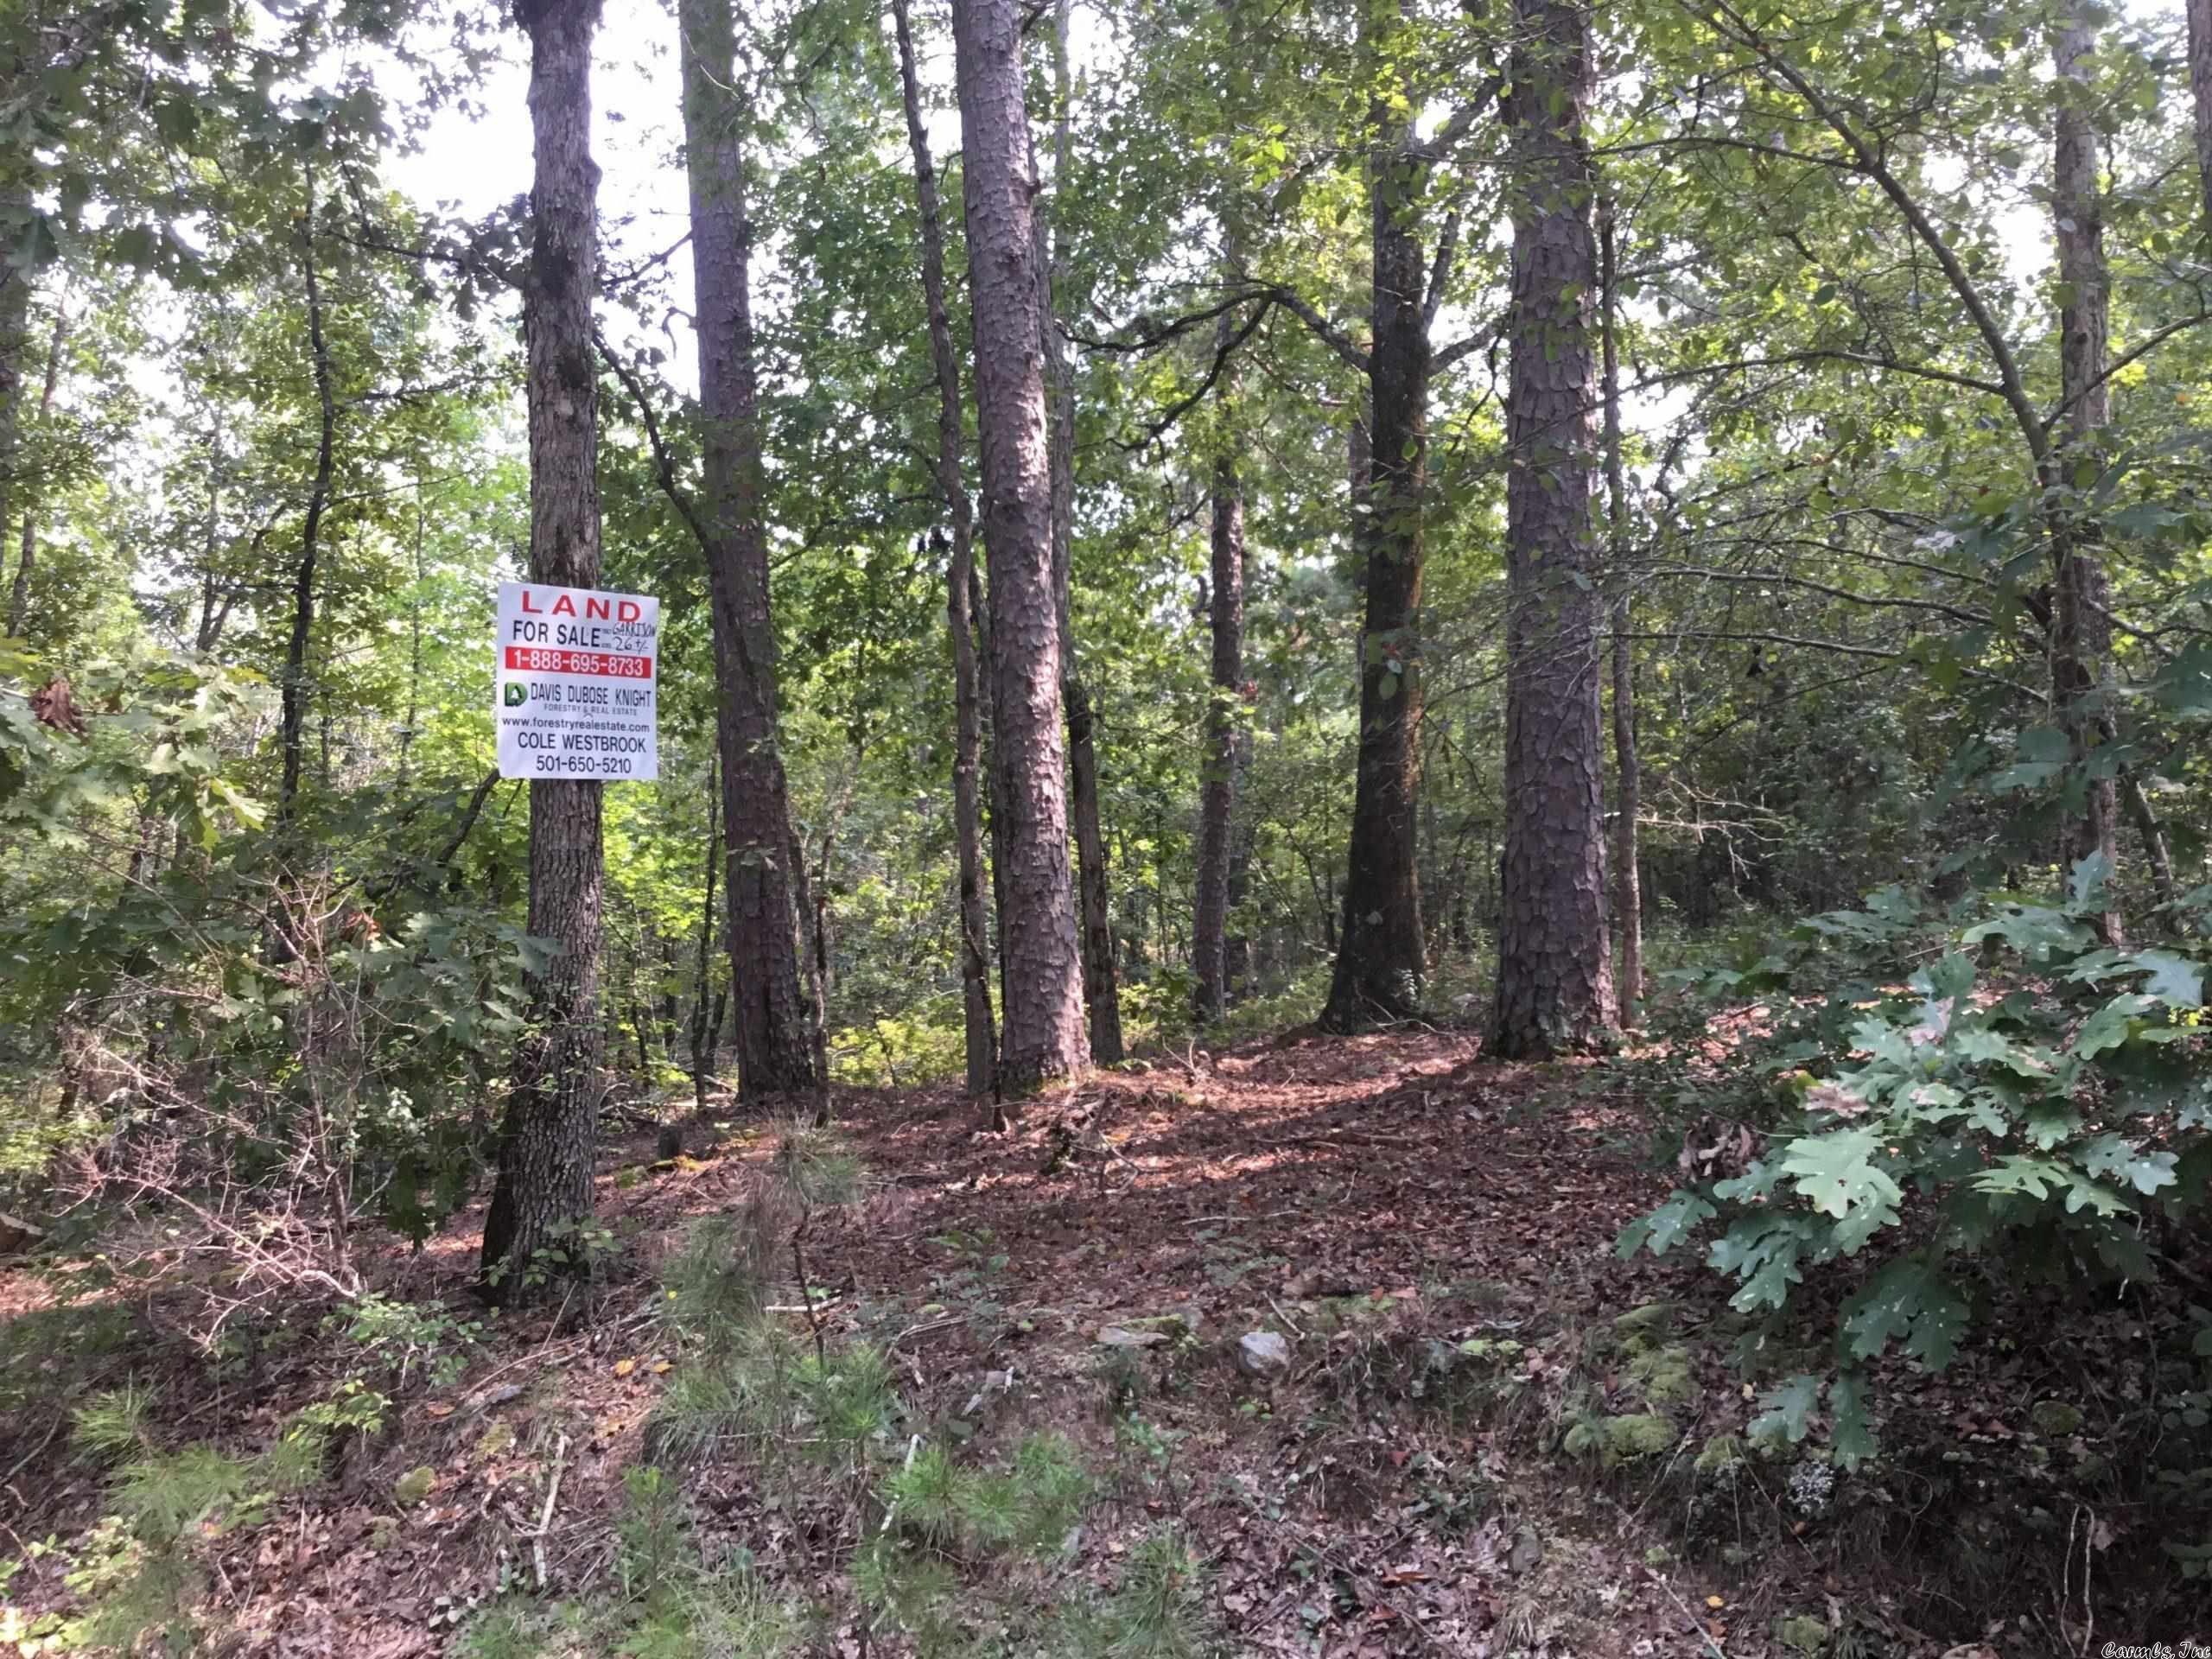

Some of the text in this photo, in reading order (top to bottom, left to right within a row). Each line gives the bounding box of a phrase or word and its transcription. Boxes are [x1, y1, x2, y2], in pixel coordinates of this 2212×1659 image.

[522, 590, 641, 622] LAND
[513, 620, 601, 647] FOR SALE
[614, 636, 632, 652] 26
[514, 649, 644, 676] 1-888-695-8733
[531, 683, 652, 707] DAVIS DUBOSE KNIGHT
[543, 703, 581, 713] FORESTRY
[591, 706, 608, 715] REAL
[612, 708, 637, 716] ESTATE
[502, 716, 650, 733] www.forestryrealestate.com
[518, 732, 646, 753] COLE WESTBROOK
[537, 755, 632, 773] 501-650-5210
